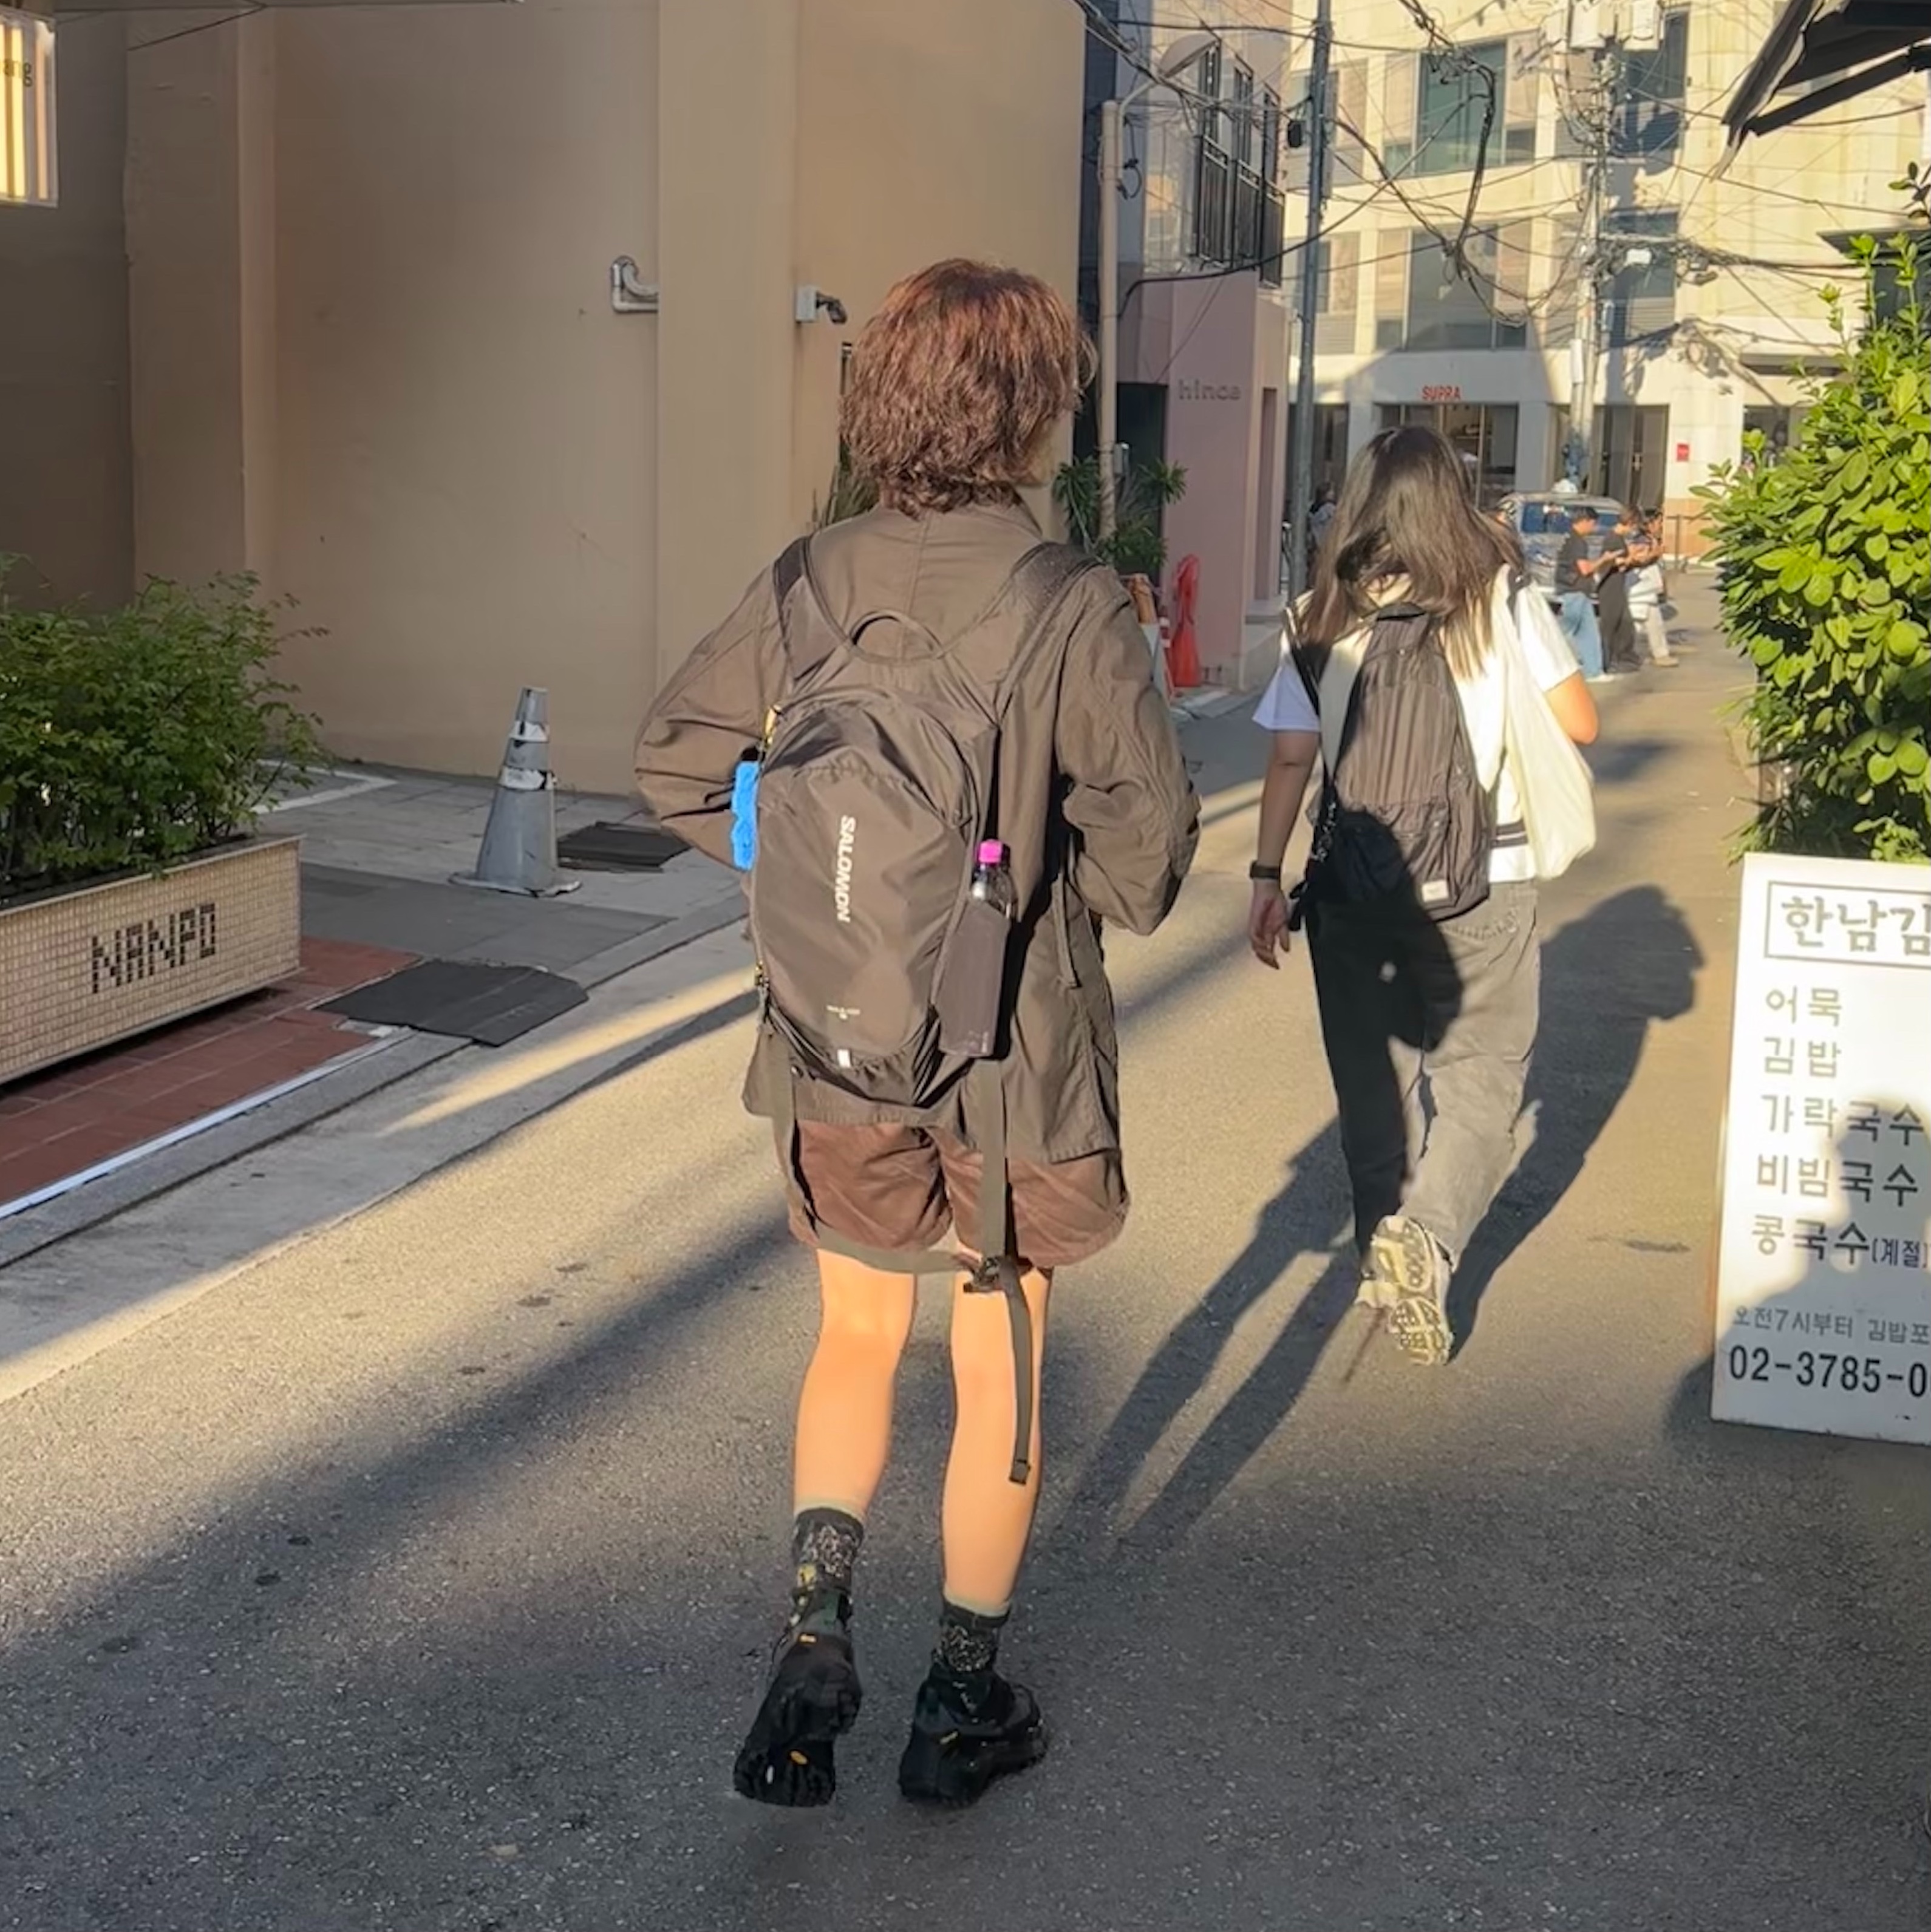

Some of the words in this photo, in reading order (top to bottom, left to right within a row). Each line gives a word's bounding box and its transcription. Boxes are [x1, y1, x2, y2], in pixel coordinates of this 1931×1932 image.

[835, 815, 856, 922] SALOMON
[92, 903, 216, 994] NANPO
[1782, 896, 1931, 955] 한남김
[1766, 985, 1842, 1027] 어묵
[1764, 1038, 1841, 1077] 김밥
[1761, 1095, 1924, 1146] 가락국수
[1757, 1155, 1918, 1206] 비빔국수
[1731, 1345, 1927, 1398] 02-3785-0
